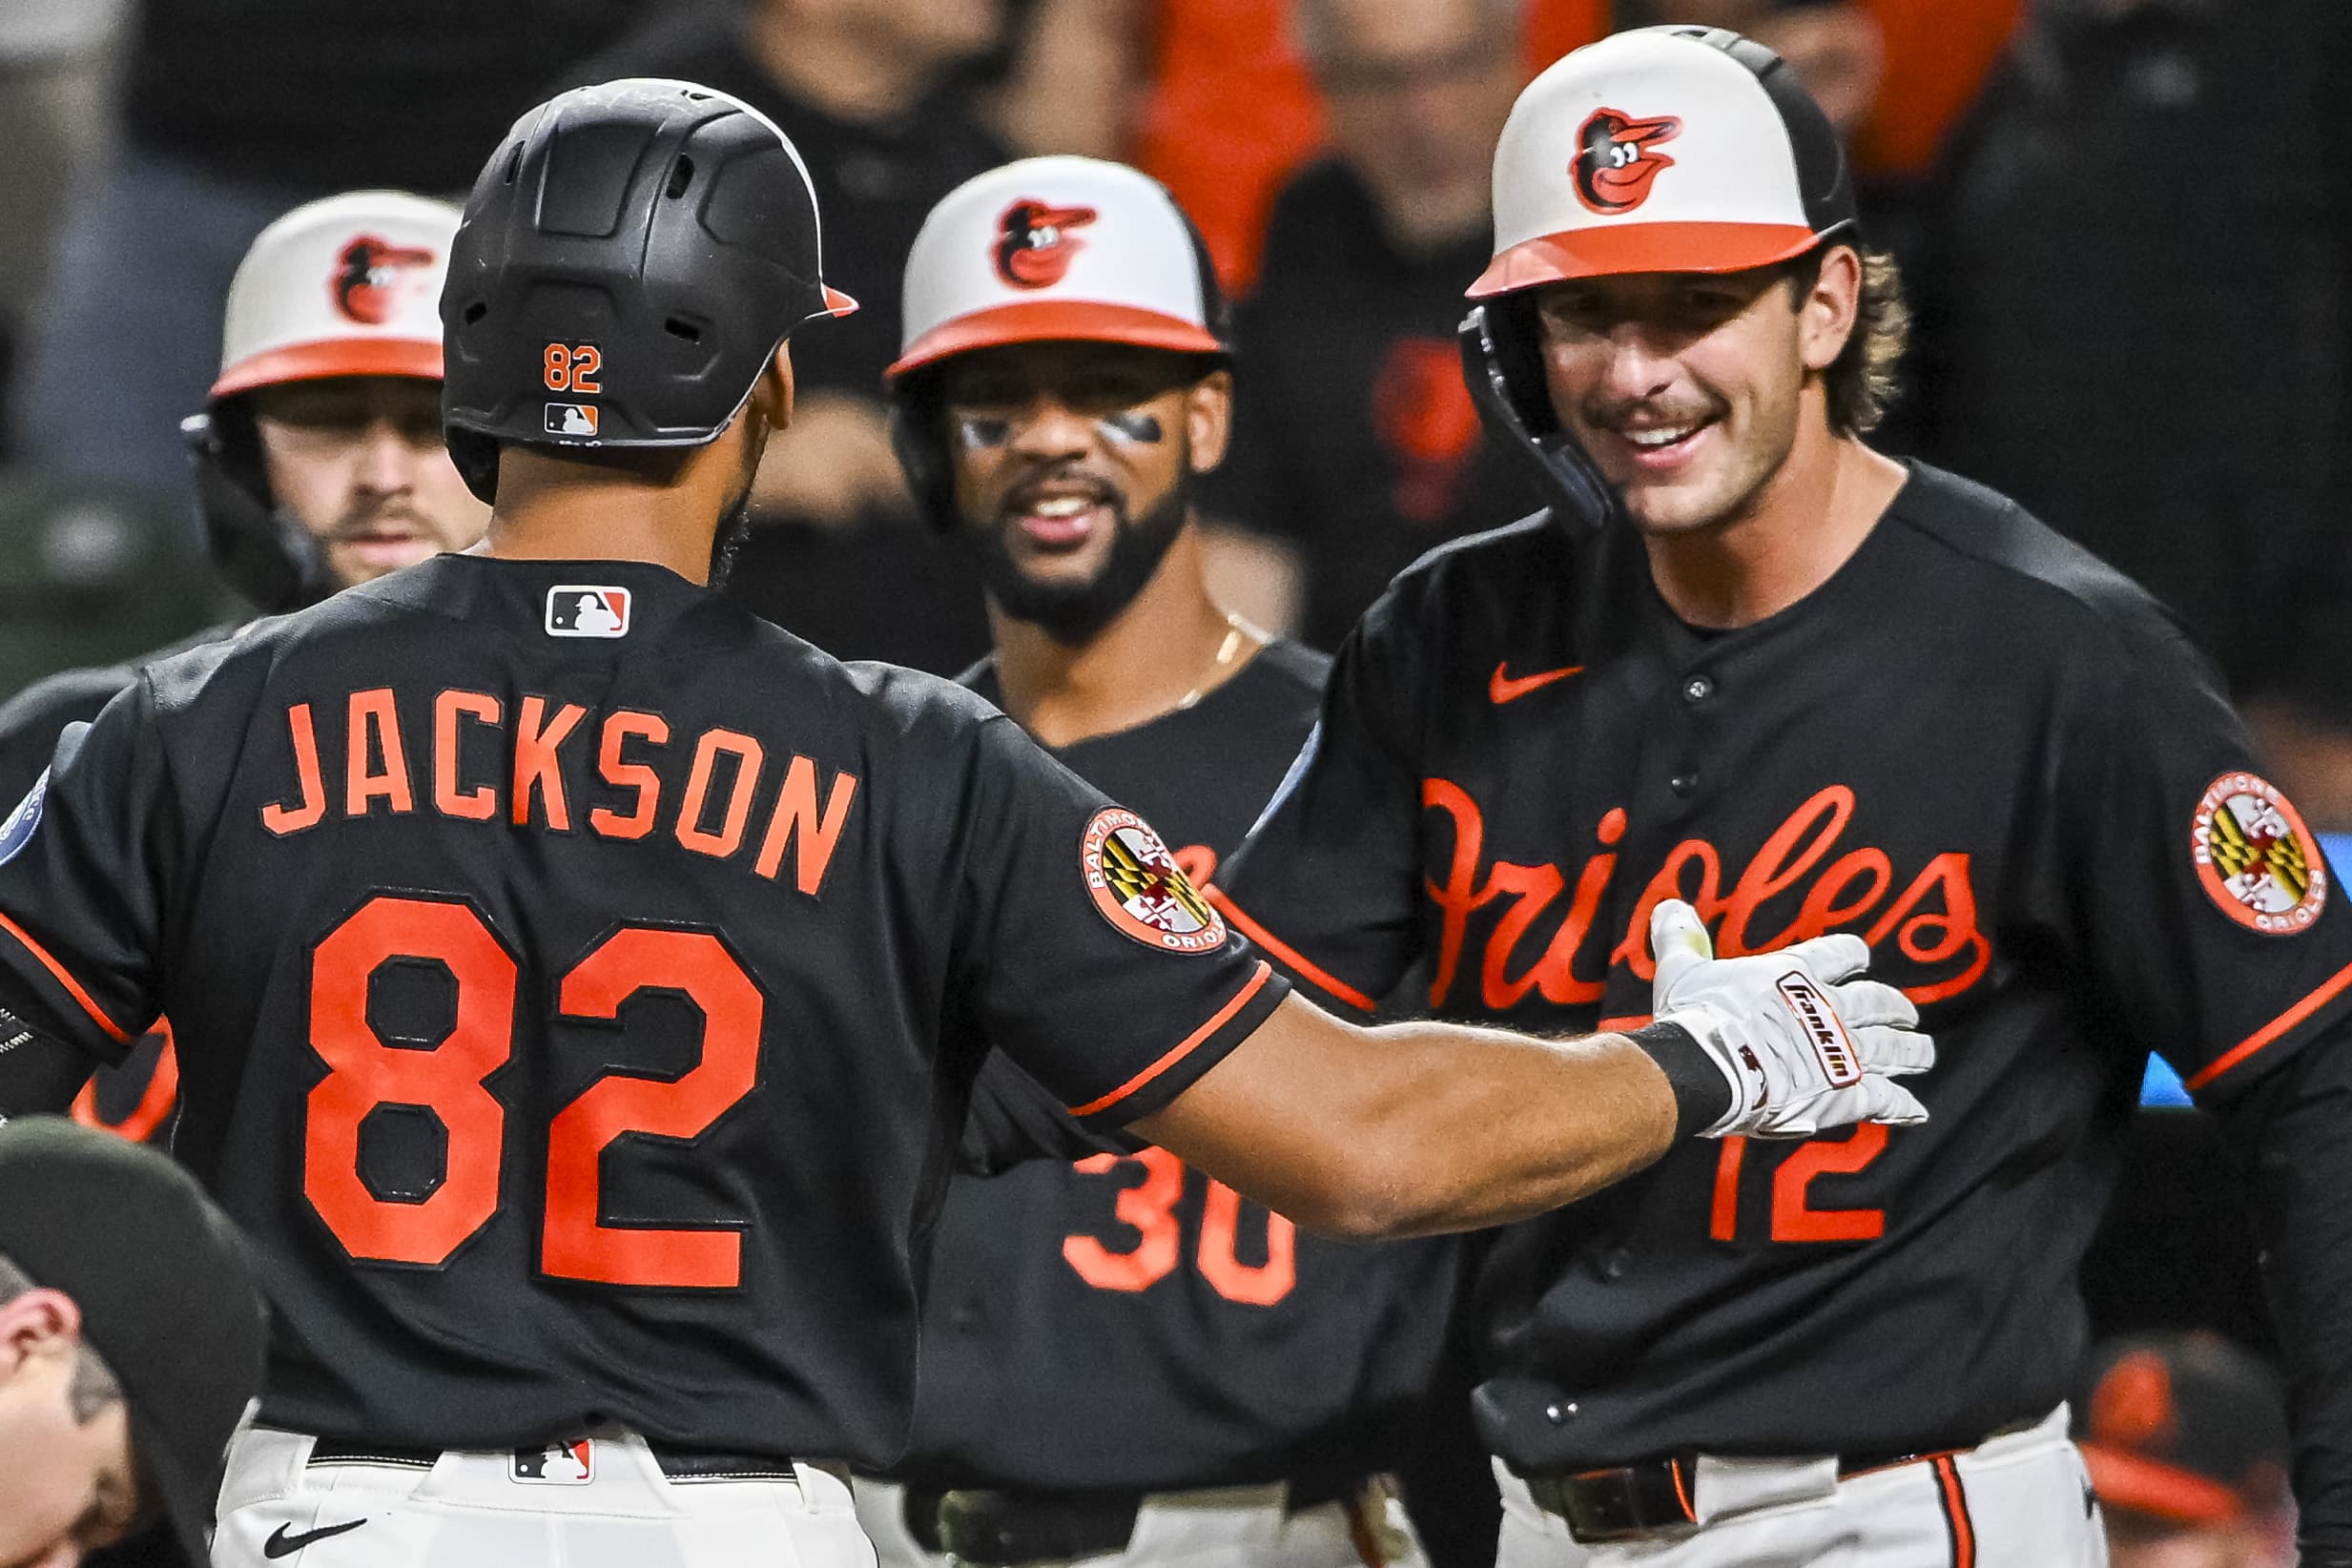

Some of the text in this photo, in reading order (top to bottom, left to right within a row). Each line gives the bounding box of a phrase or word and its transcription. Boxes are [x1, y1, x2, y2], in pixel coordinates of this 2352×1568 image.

[544, 343, 602, 394] 82
[261, 687, 859, 896] JACKSON
[1085, 813, 1152, 889] BALTIMO
[303, 895, 766, 1288] 82
